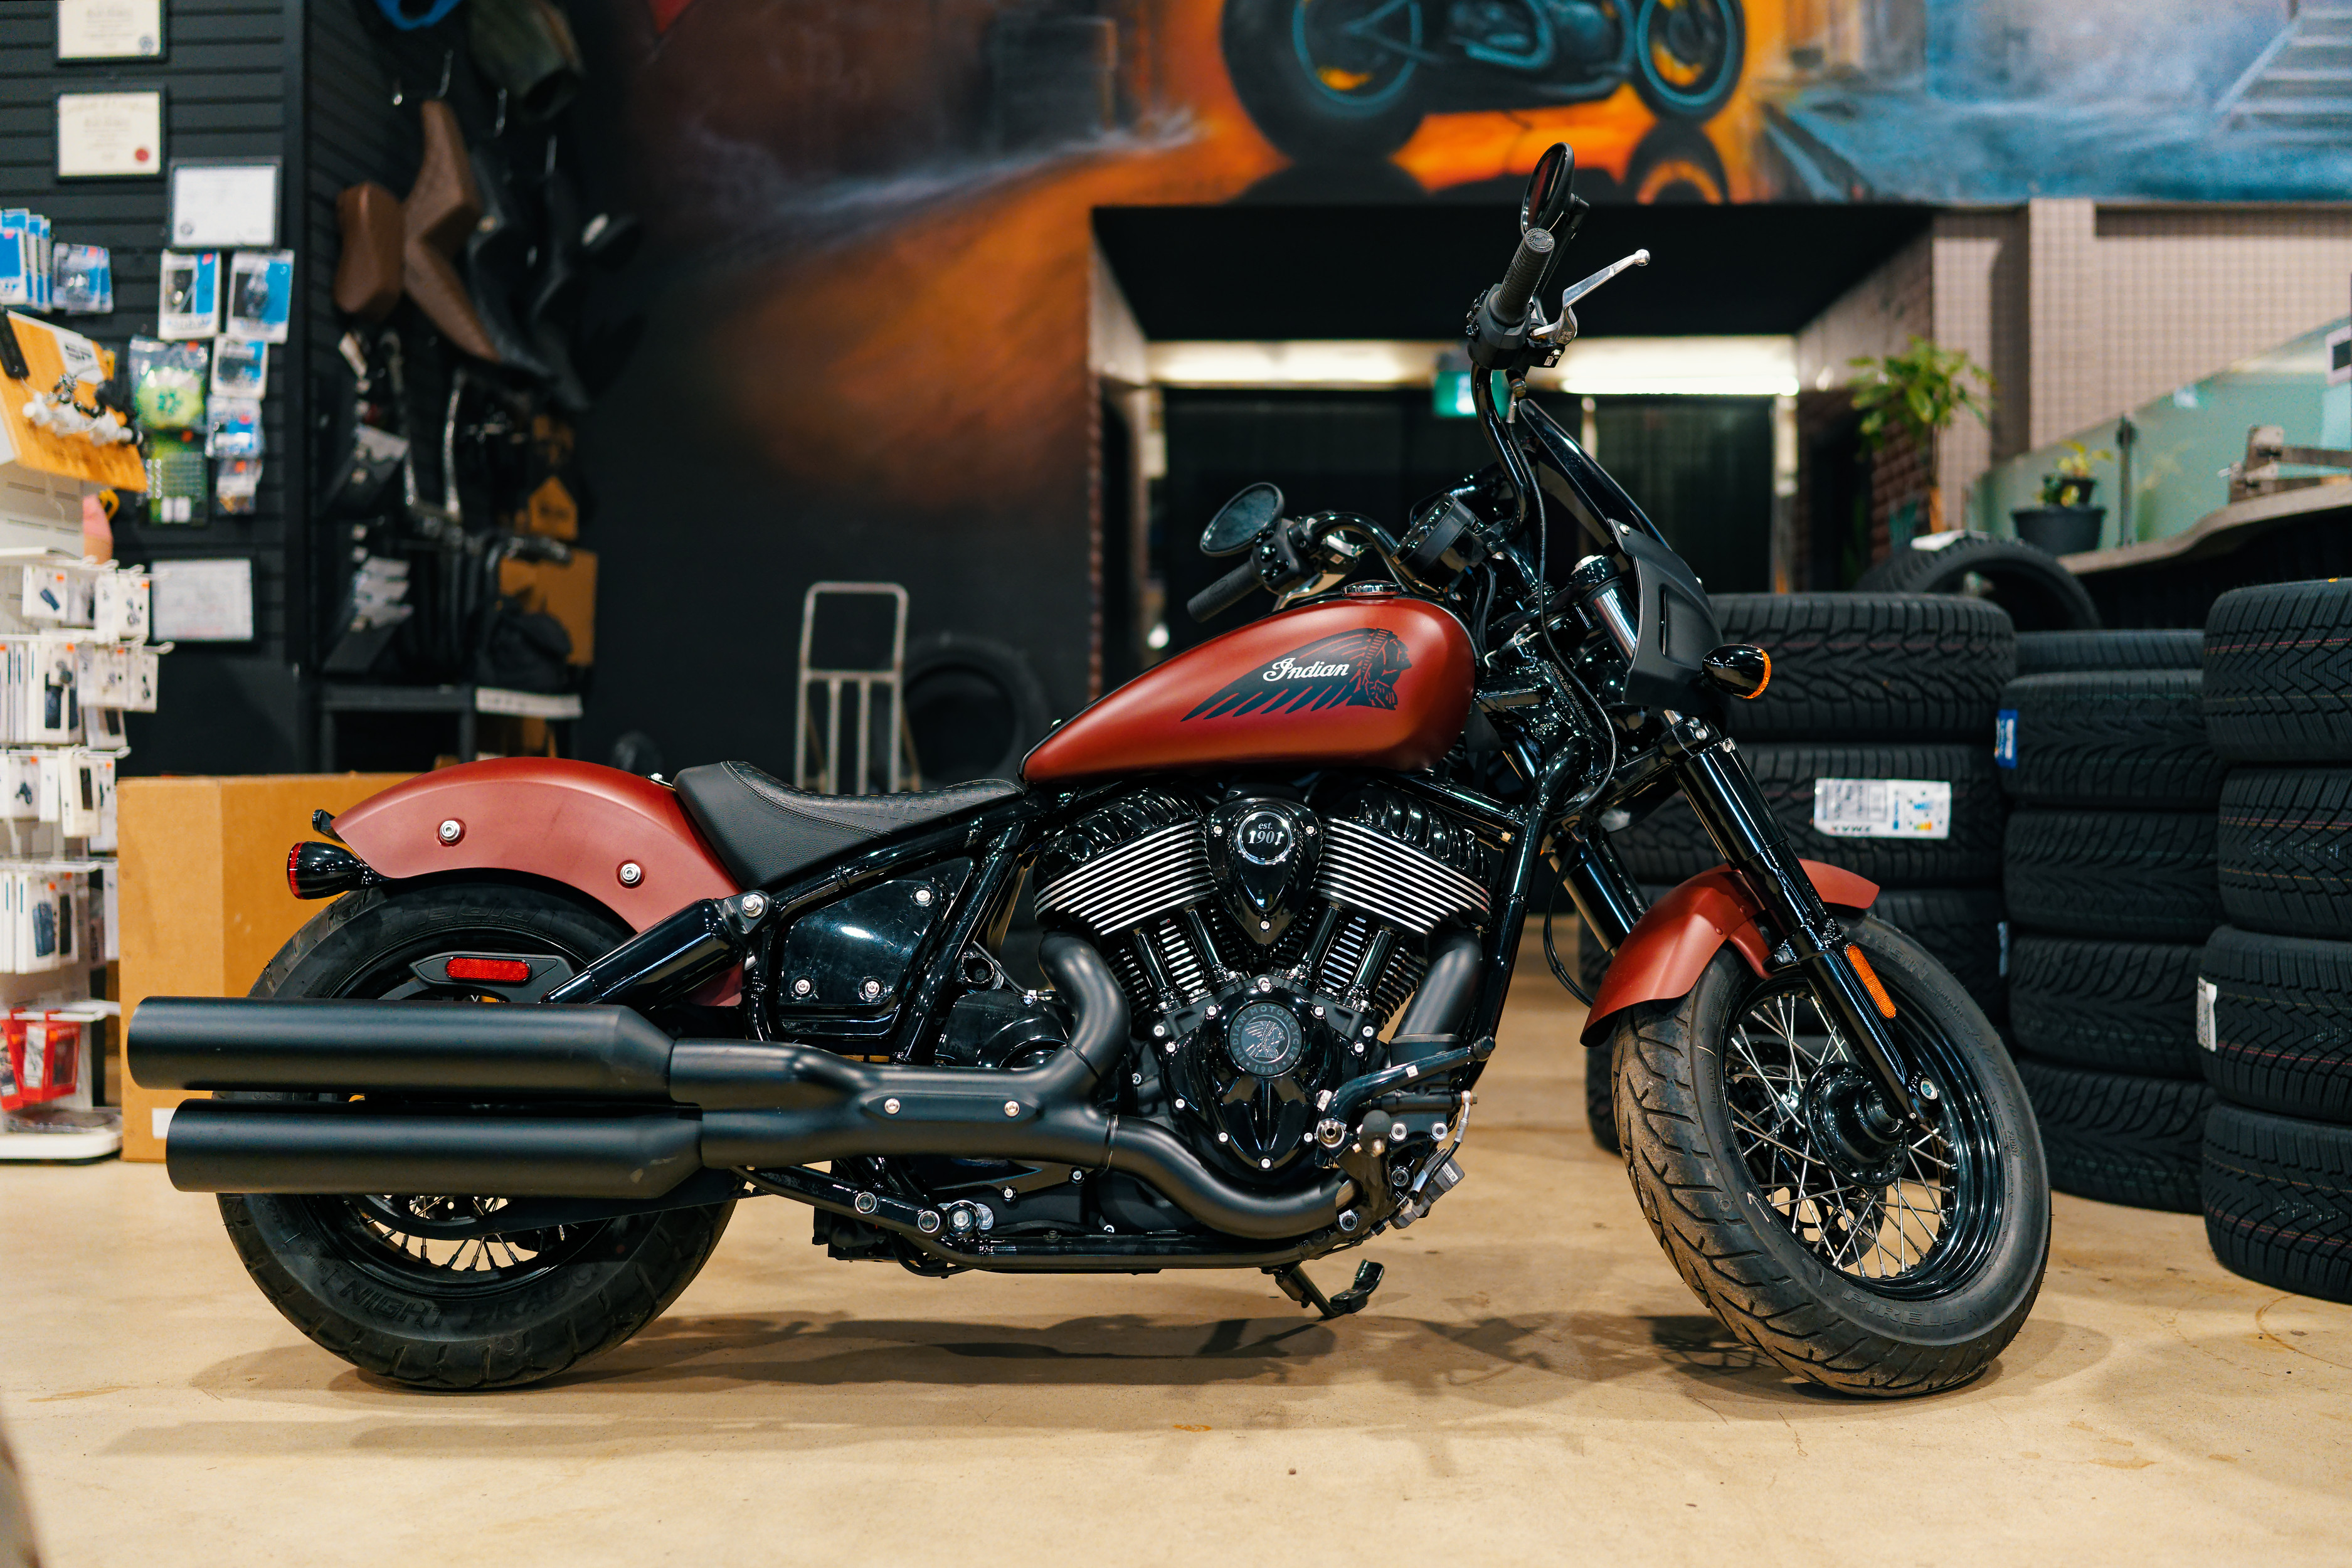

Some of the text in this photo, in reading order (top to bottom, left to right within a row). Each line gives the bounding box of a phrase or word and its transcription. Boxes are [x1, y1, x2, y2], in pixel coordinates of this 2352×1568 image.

[1263, 657, 1350, 682] Indian
[1248, 830, 1284, 844] 1901
[1232, 1005, 1300, 1061] INDIAN MOTORCYCLE
[1254, 1064, 1280, 1073] 1901
